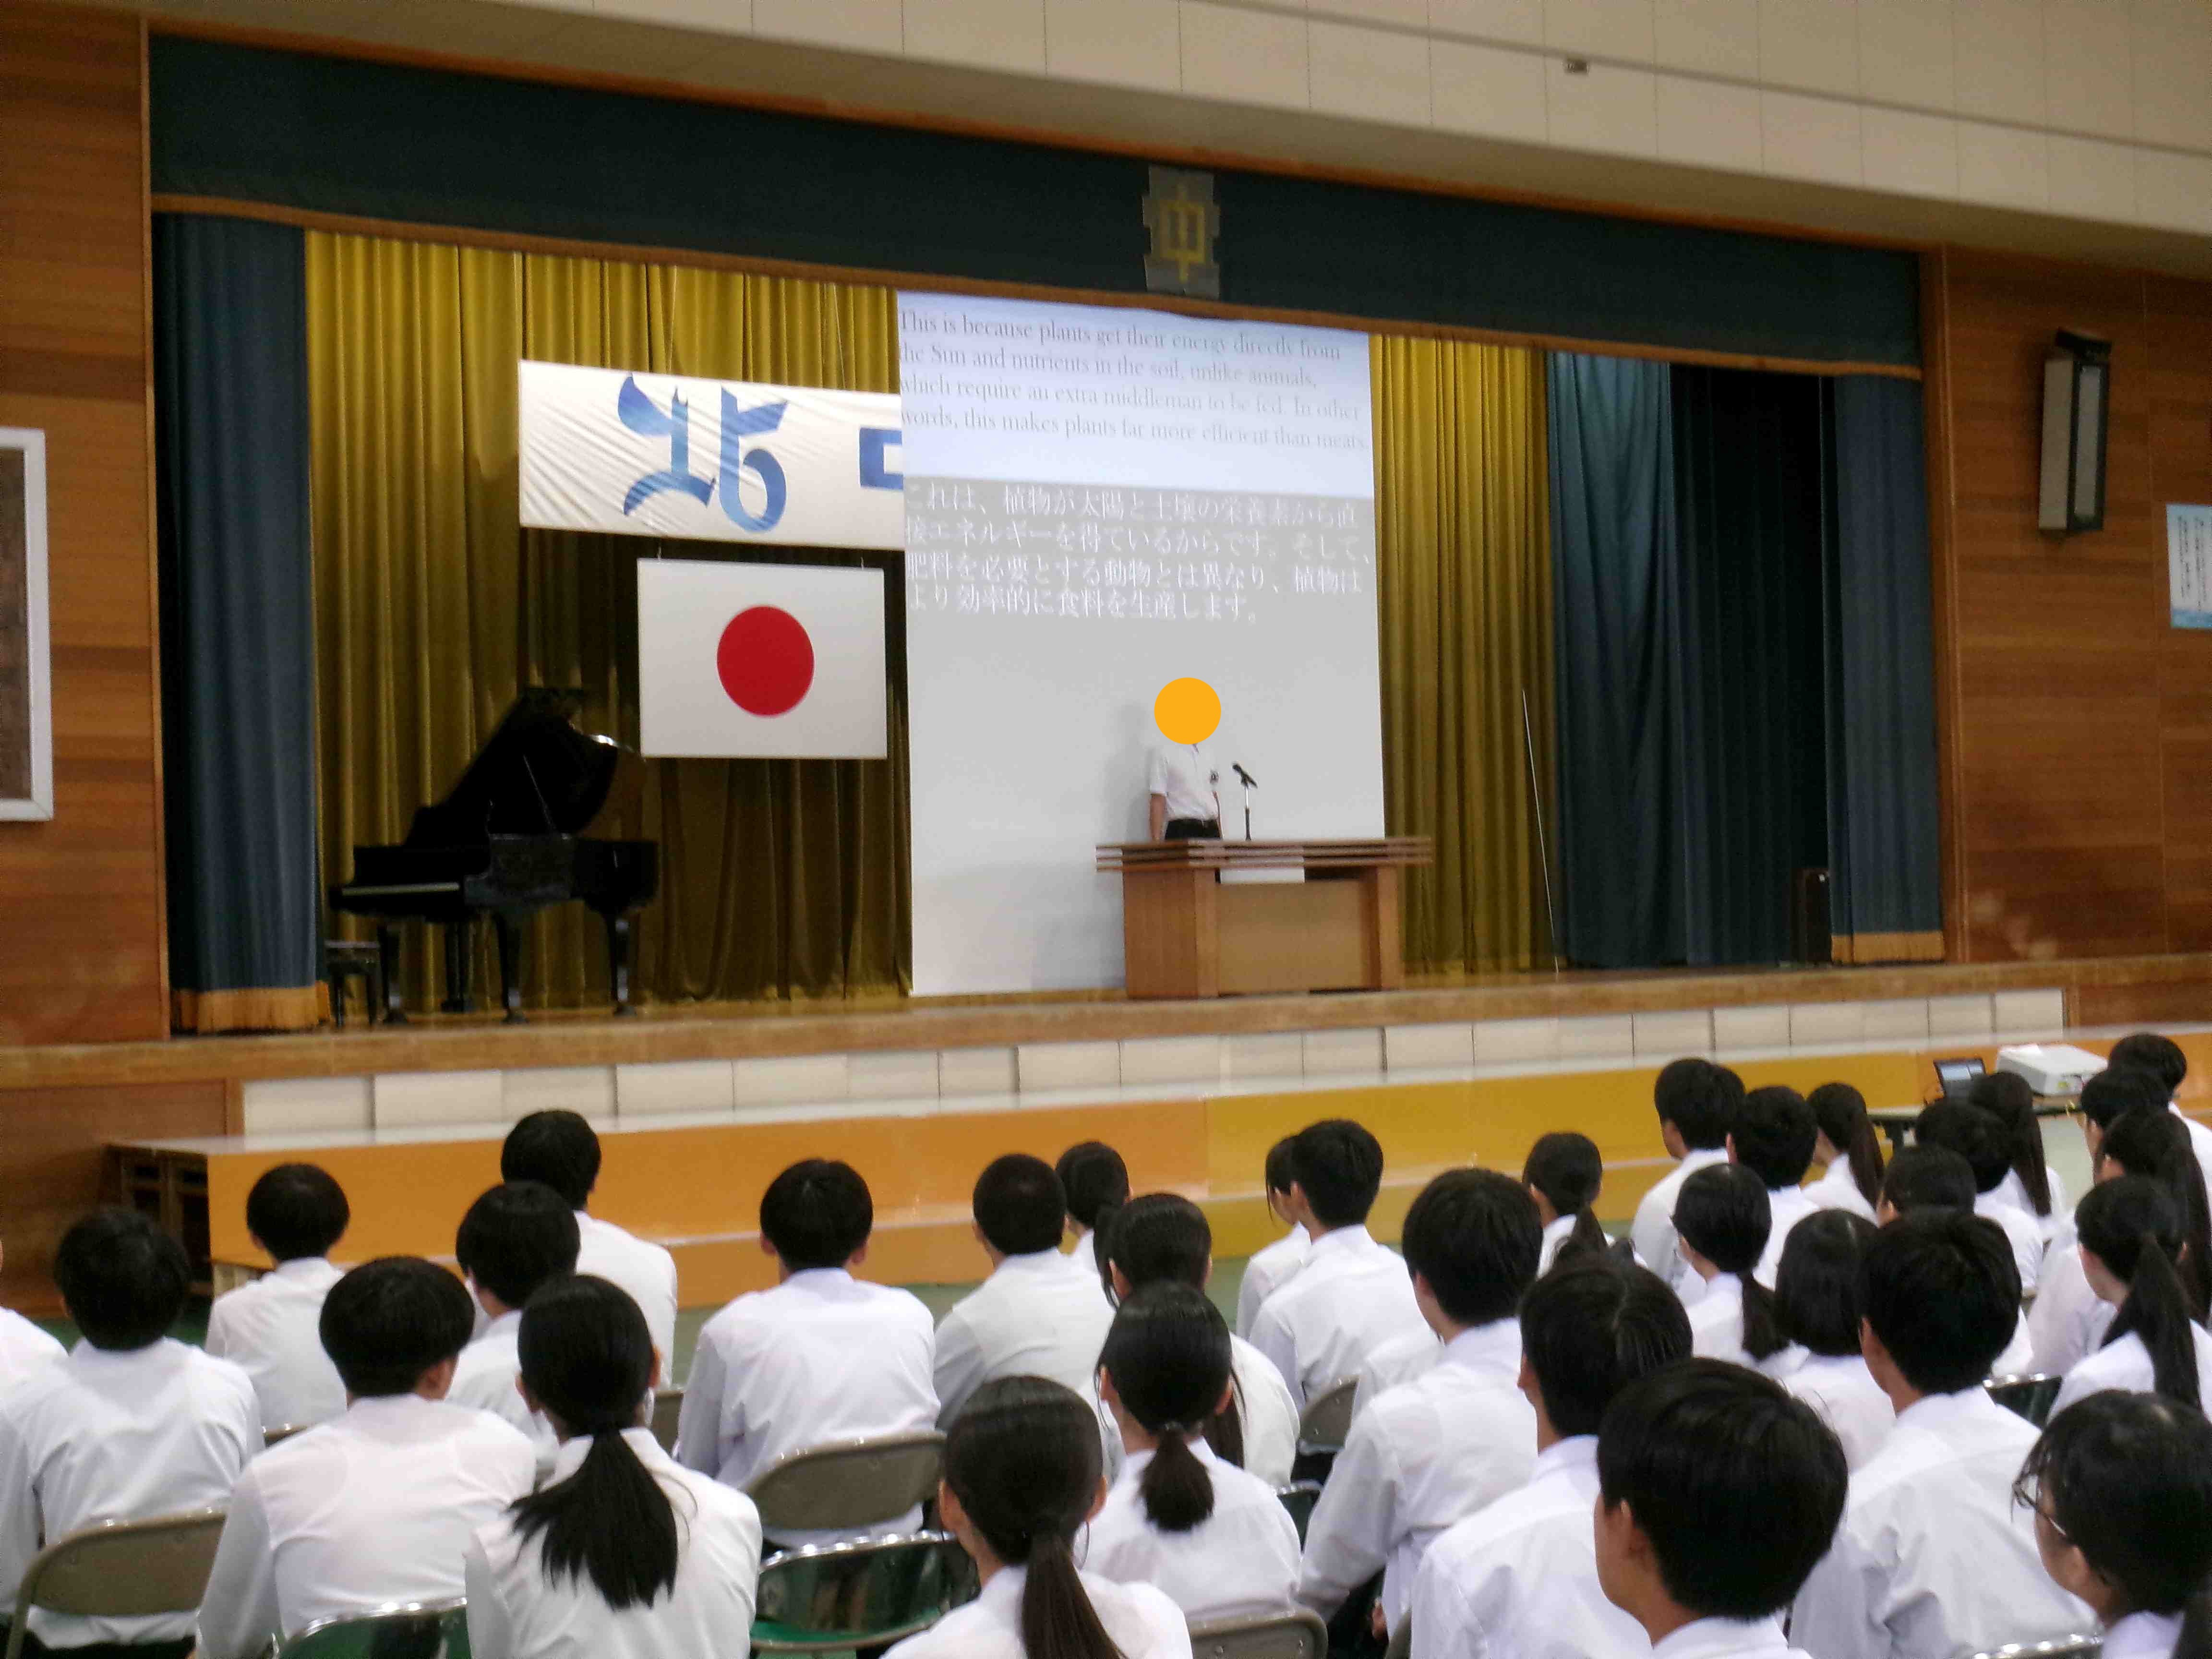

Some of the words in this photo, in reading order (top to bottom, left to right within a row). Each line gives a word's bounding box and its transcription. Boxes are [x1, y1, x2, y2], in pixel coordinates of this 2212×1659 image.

[944, 312, 956, 334] is
[962, 312, 1032, 338] because
[1040, 319, 1091, 346] plants
[1095, 328, 1121, 348] get
[1127, 324, 1165, 349] their
[1172, 334, 1225, 354] energy
[1233, 332, 1292, 356] directly
[1300, 337, 1341, 361] from
[931, 344, 967, 367] Sun
[973, 346, 1005, 369] and
[1012, 349, 1089, 373] nutrients
[1095, 349, 1111, 375] in
[1118, 354, 1144, 376] the
[1190, 360, 1243, 382] unlike
[1249, 365, 1317, 391] animals,
[957, 376, 1022, 403] require
[1029, 387, 1049, 400] an
[1055, 387, 1097, 404] extra
[1104, 384, 1202, 411] middleman
[1208, 393, 1224, 409] to
[1230, 392, 1246, 412] be
[1294, 396, 1311, 417] In
[1317, 398, 1360, 421] other
[964, 407, 997, 429] this
[1003, 410, 1059, 433] makes
[1065, 411, 1117, 441] plants
[1122, 415, 1144, 439] far
[1152, 424, 1194, 441] more
[1202, 423, 1268, 446] efficient
[1274, 425, 1310, 447] than
